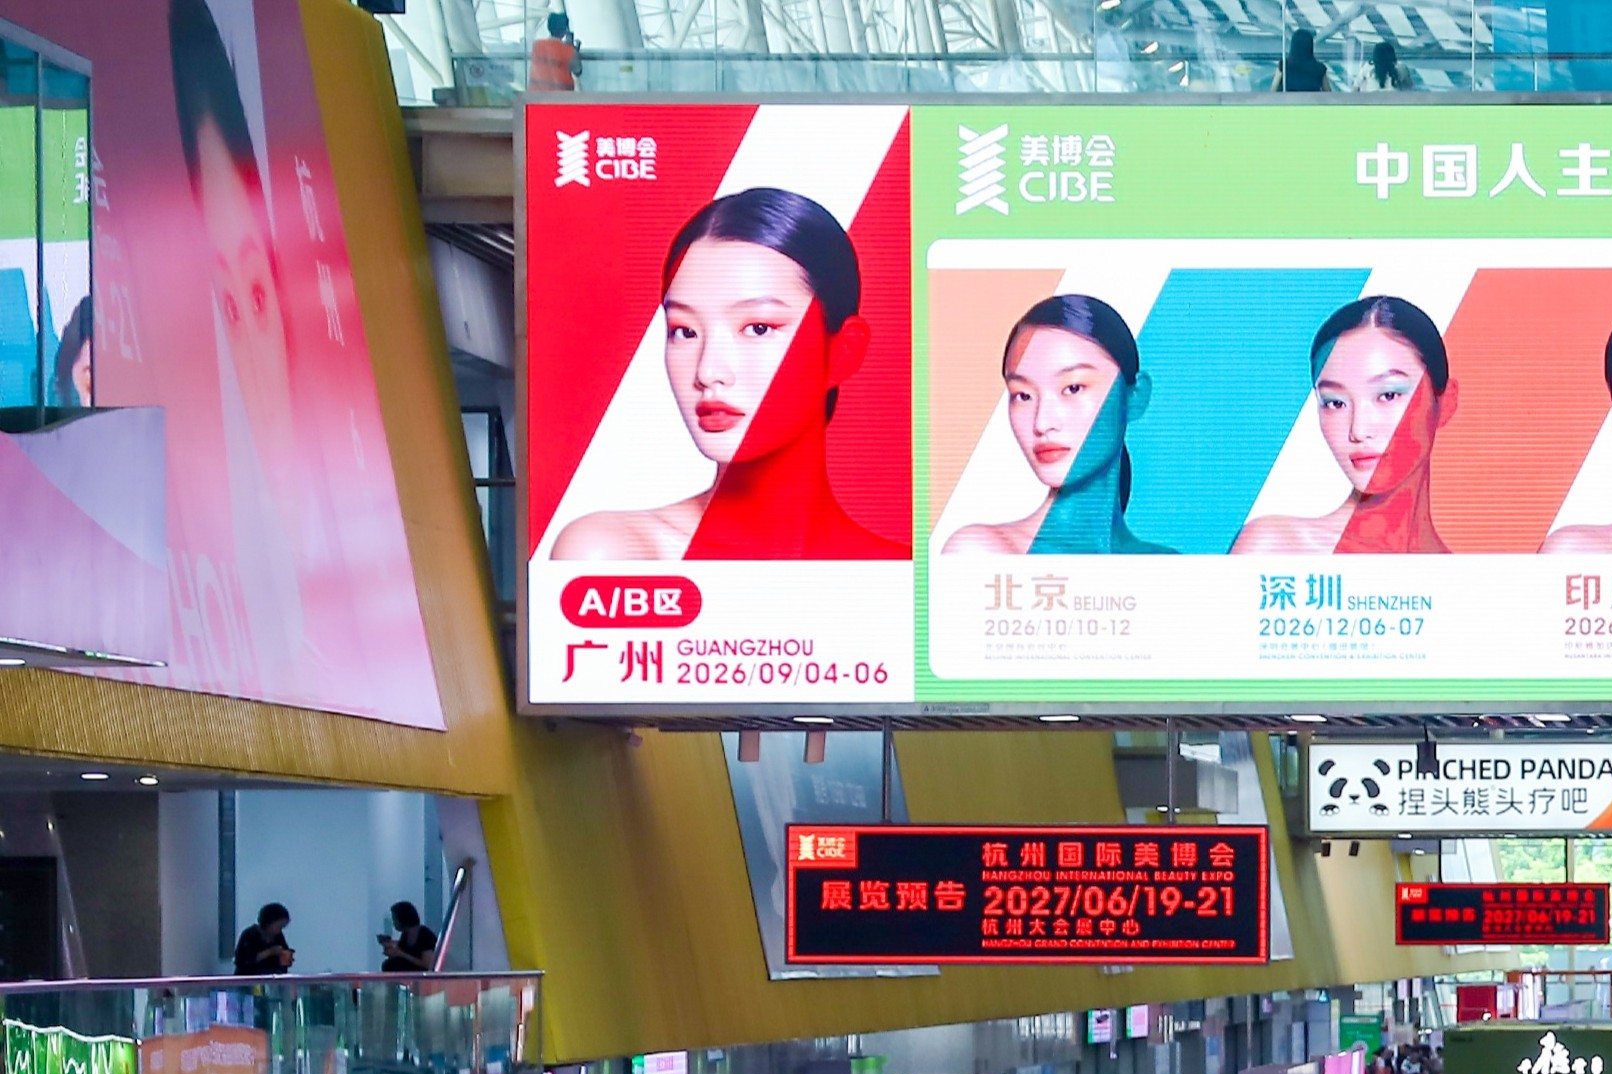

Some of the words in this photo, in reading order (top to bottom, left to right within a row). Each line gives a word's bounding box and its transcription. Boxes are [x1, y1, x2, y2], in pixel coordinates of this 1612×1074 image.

[595, 137, 657, 157] 美博会
[1020, 134, 1116, 166] 美博会
[595, 159, 657, 180] CIBE
[1020, 172, 1116, 202] CIBE
[578, 587, 683, 617] A/B区
[985, 574, 1069, 611] 北京
[1074, 596, 1137, 611] BEIJING
[1259, 574, 1342, 611] 深圳
[1347, 596, 1432, 610] SHENZHEN
[985, 619, 1130, 637] 2026/10/10-12
[1259, 618, 1424, 637] 2026/12/06-07
[677, 639, 814, 657] GUANGZHOU
[561, 640, 664, 684] 广州
[677, 661, 888, 686] 2026/09/04-06
[1398, 787, 1589, 816] 捏头熊头疗吧
[982, 842, 1235, 868] 杭州国际美博会
[982, 871, 1051, 881] HANGZHOU
[1056, 871, 1149, 881] INTERNATIONAL
[1154, 871, 1197, 881] BEAUTY
[1201, 871, 1234, 881] EXPO
[821, 880, 966, 911] 展览预告
[983, 885, 1234, 916] 2027/06/19-21
[982, 918, 1140, 936] 杭州大会展中心
